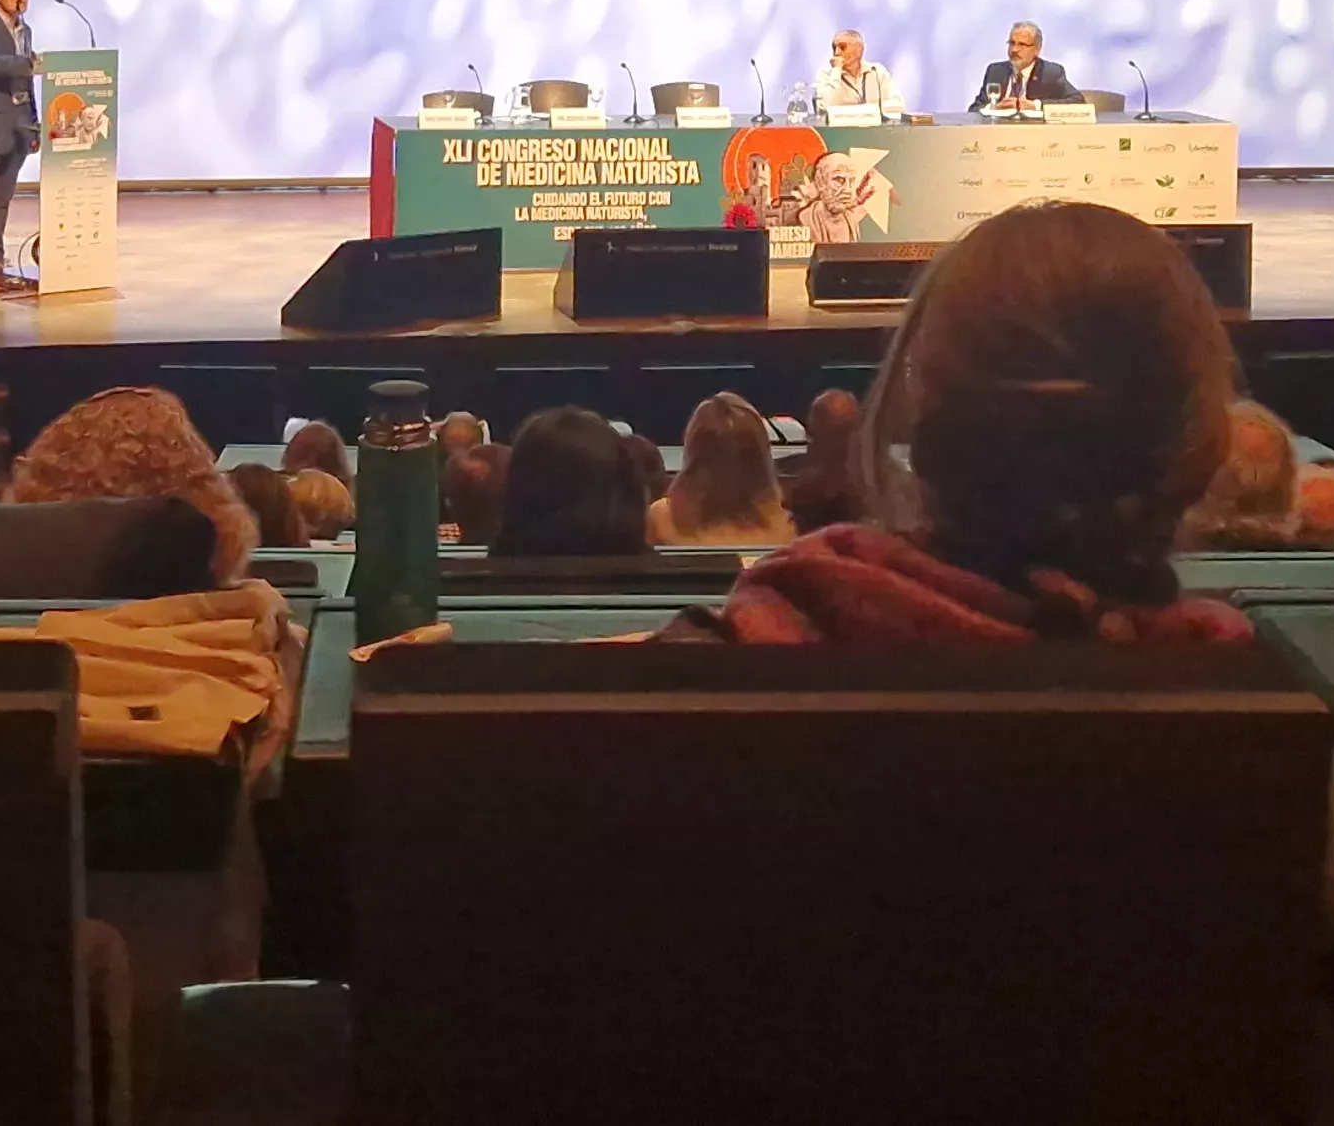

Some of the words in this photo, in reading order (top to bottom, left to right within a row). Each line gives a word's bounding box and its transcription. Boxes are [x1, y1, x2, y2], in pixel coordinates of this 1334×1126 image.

[443, 138, 473, 164] XLI
[476, 137, 576, 163] CONGRESO
[580, 136, 673, 162] NACIONAL
[476, 162, 502, 187] DE
[506, 161, 598, 186] MEDICINA
[600, 160, 701, 185] NATURISTA
[532, 191, 588, 207] CUIDANDO
[589, 191, 603, 207] EL
[604, 191, 647, 206] FUTURO
[648, 190, 672, 206] CON
[514, 206, 530, 222] LA
[530, 206, 585, 222] MEDICINA
[585, 205, 649, 222] NATURISTA,
